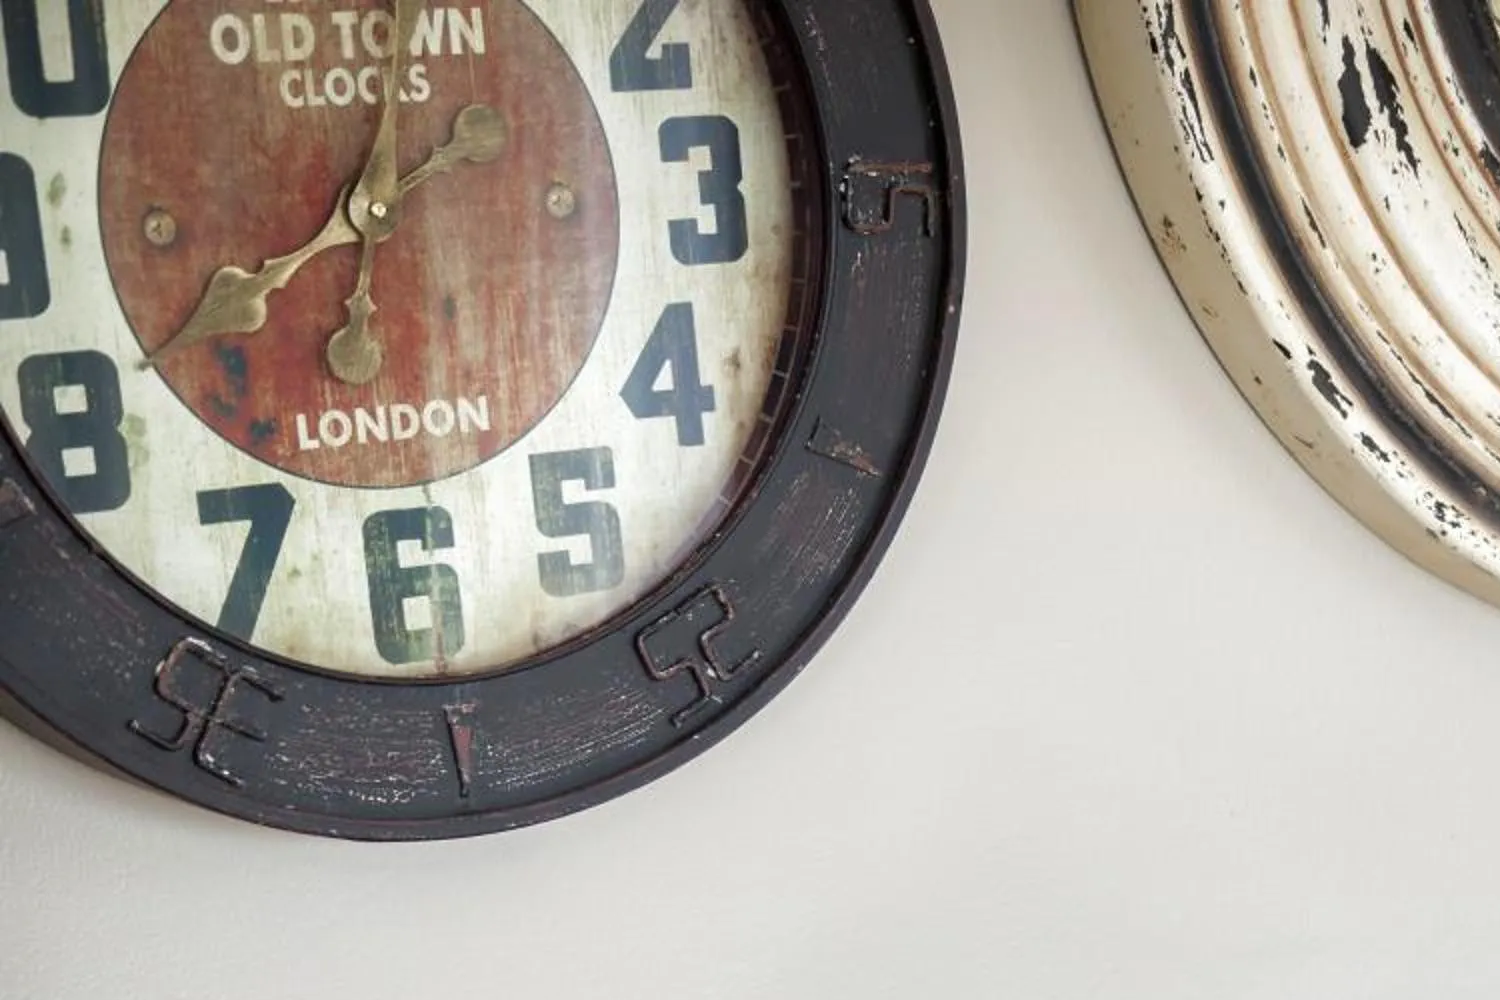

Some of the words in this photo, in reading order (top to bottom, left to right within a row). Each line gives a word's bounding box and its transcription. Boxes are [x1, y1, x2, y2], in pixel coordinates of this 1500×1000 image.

[210, 13, 315, 65] OLD
[331, 7, 485, 58] TOWN
[659, 115, 746, 266] 3
[15, 349, 132, 515] 8
[297, 396, 490, 451] LONDON
[619, 302, 716, 448] 4
[195, 482, 296, 647] 7
[361, 506, 466, 665] 6
[527, 445, 624, 598] 5
